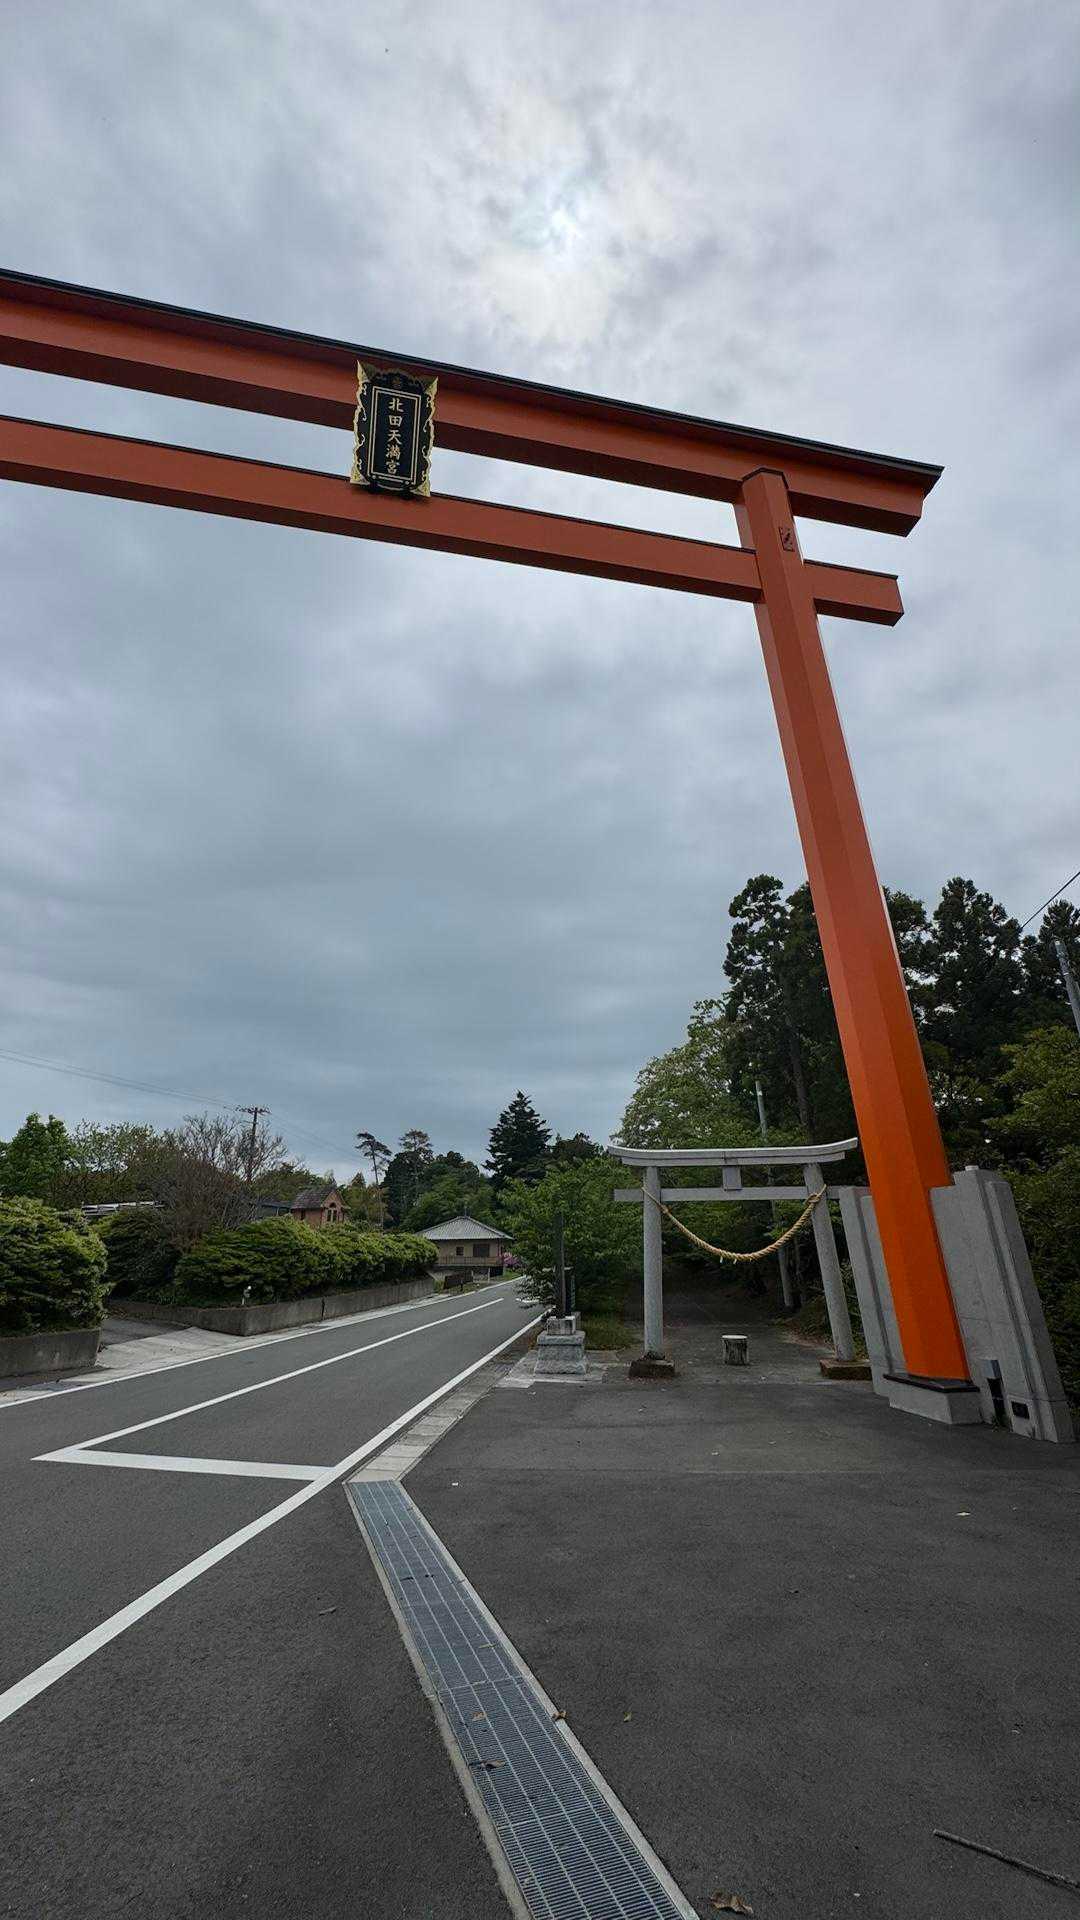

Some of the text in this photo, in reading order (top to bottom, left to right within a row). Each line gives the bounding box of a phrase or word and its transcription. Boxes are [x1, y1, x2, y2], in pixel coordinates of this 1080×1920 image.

[385, 397, 404, 475] 北田天満宮
